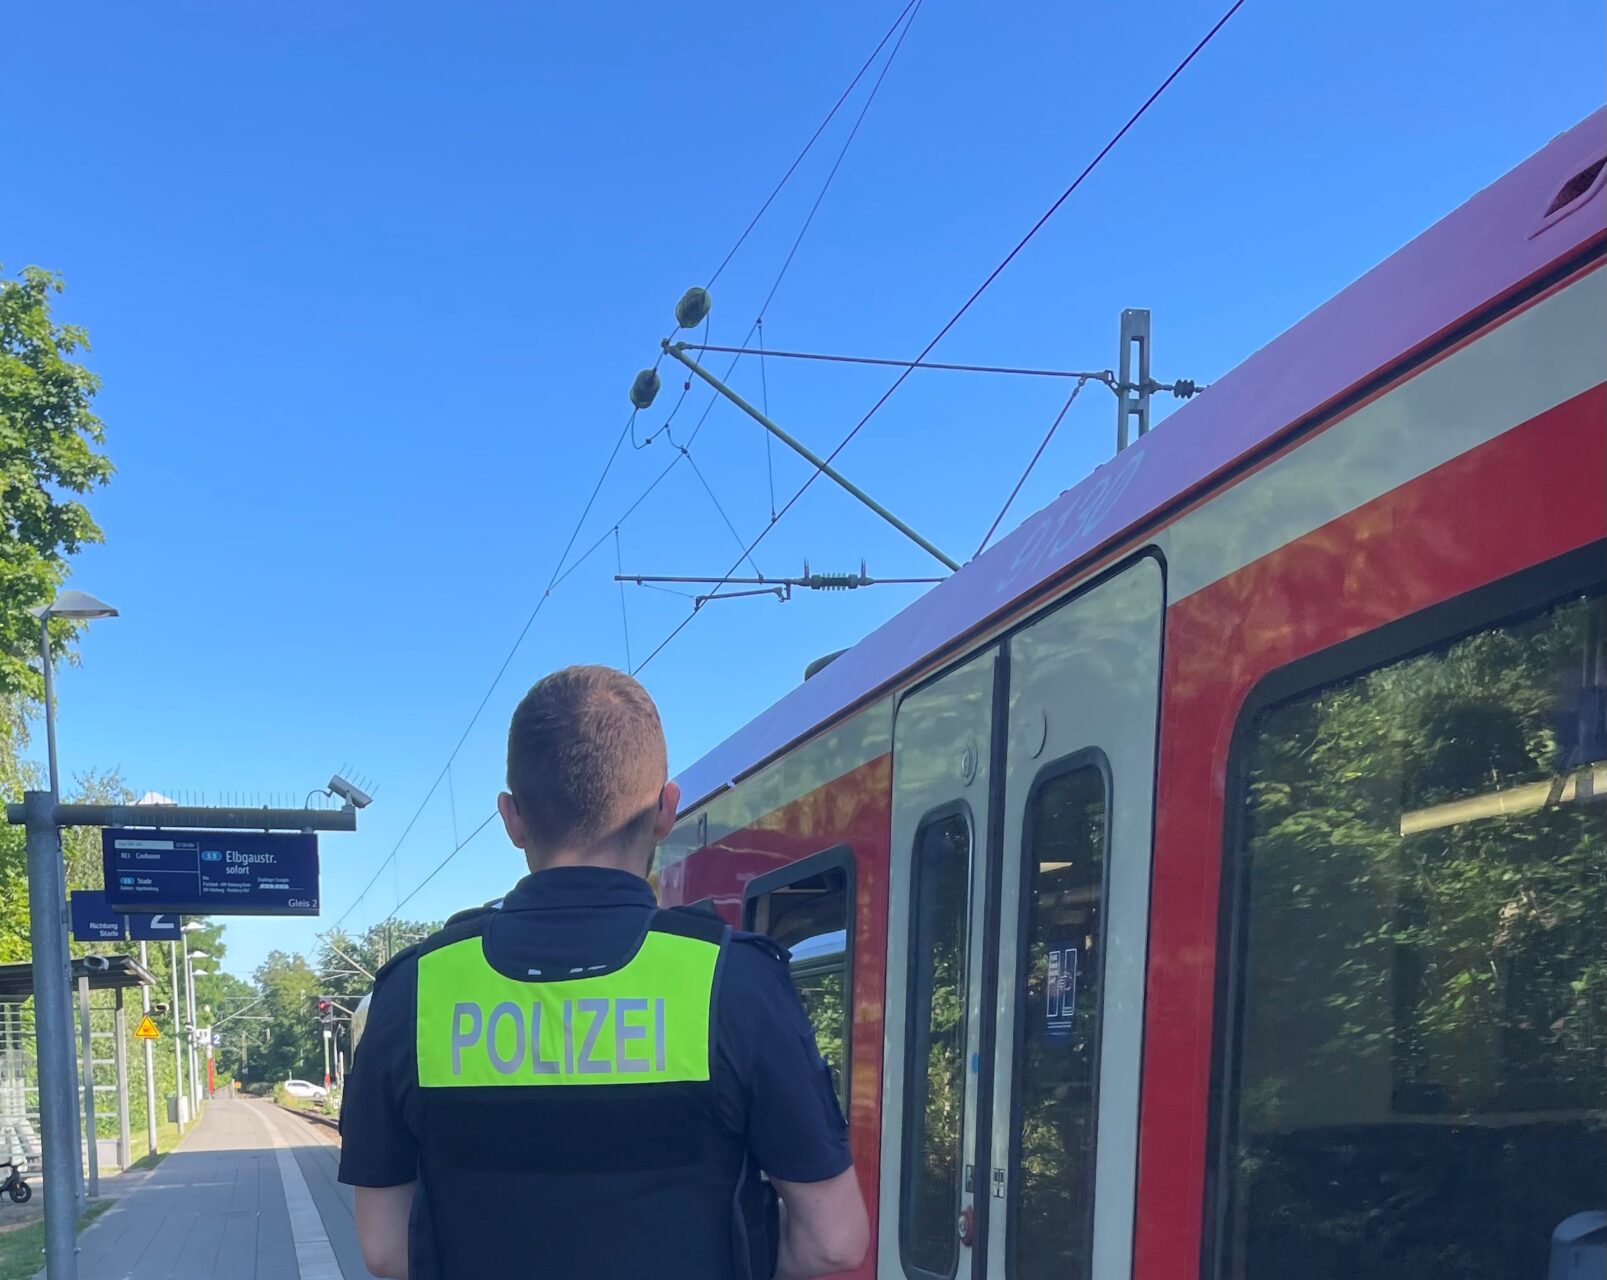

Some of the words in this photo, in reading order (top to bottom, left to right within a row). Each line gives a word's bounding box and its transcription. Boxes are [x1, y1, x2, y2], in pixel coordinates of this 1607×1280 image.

[225, 850, 278, 866] Elbgaustr.
[225, 866, 251, 875] sofort
[288, 898, 311, 908] Gleis
[311, 899, 318, 908] 2
[89, 922, 119, 931] Richtung
[213, 1034, 221, 1044] 2
[451, 997, 666, 1076] POLIZEI
